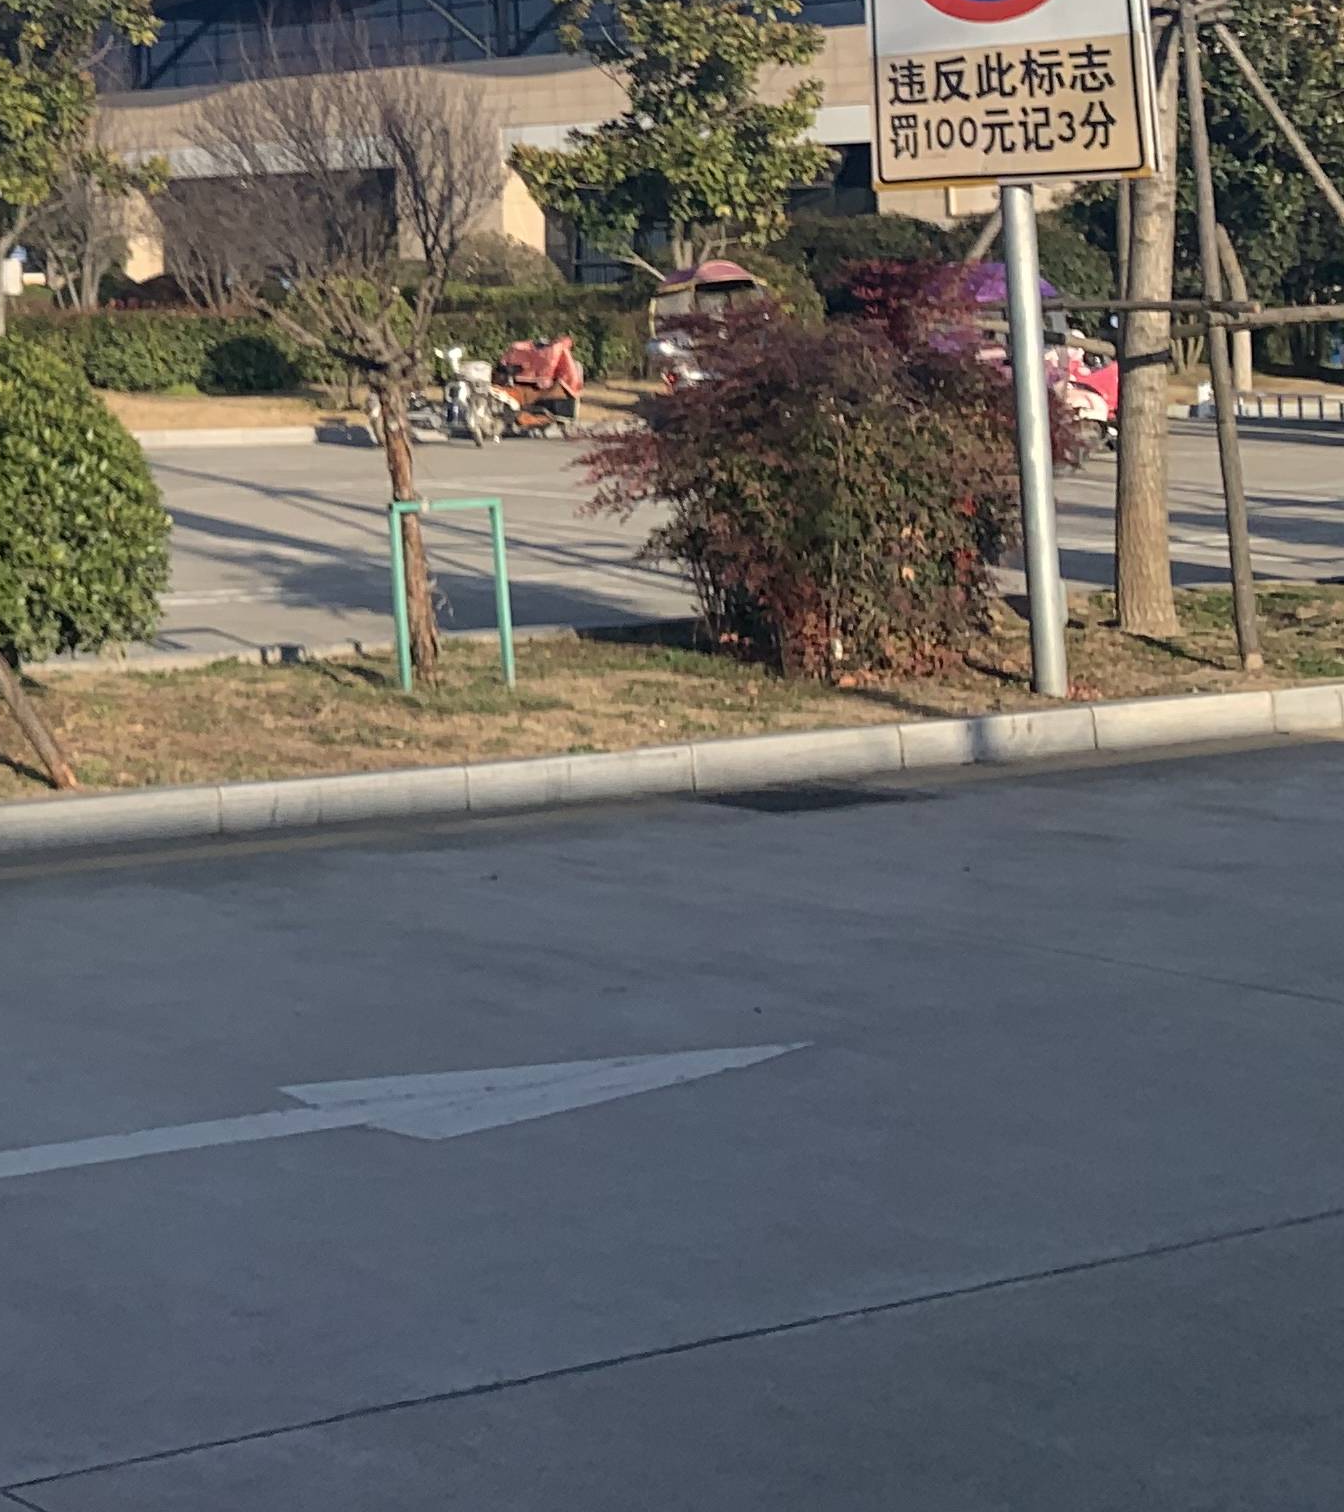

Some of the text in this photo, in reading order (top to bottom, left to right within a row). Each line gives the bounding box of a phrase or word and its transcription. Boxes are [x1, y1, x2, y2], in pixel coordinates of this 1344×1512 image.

[888, 44, 1116, 106] 违反此标志
[890, 100, 1117, 159] 罚100元记3分
